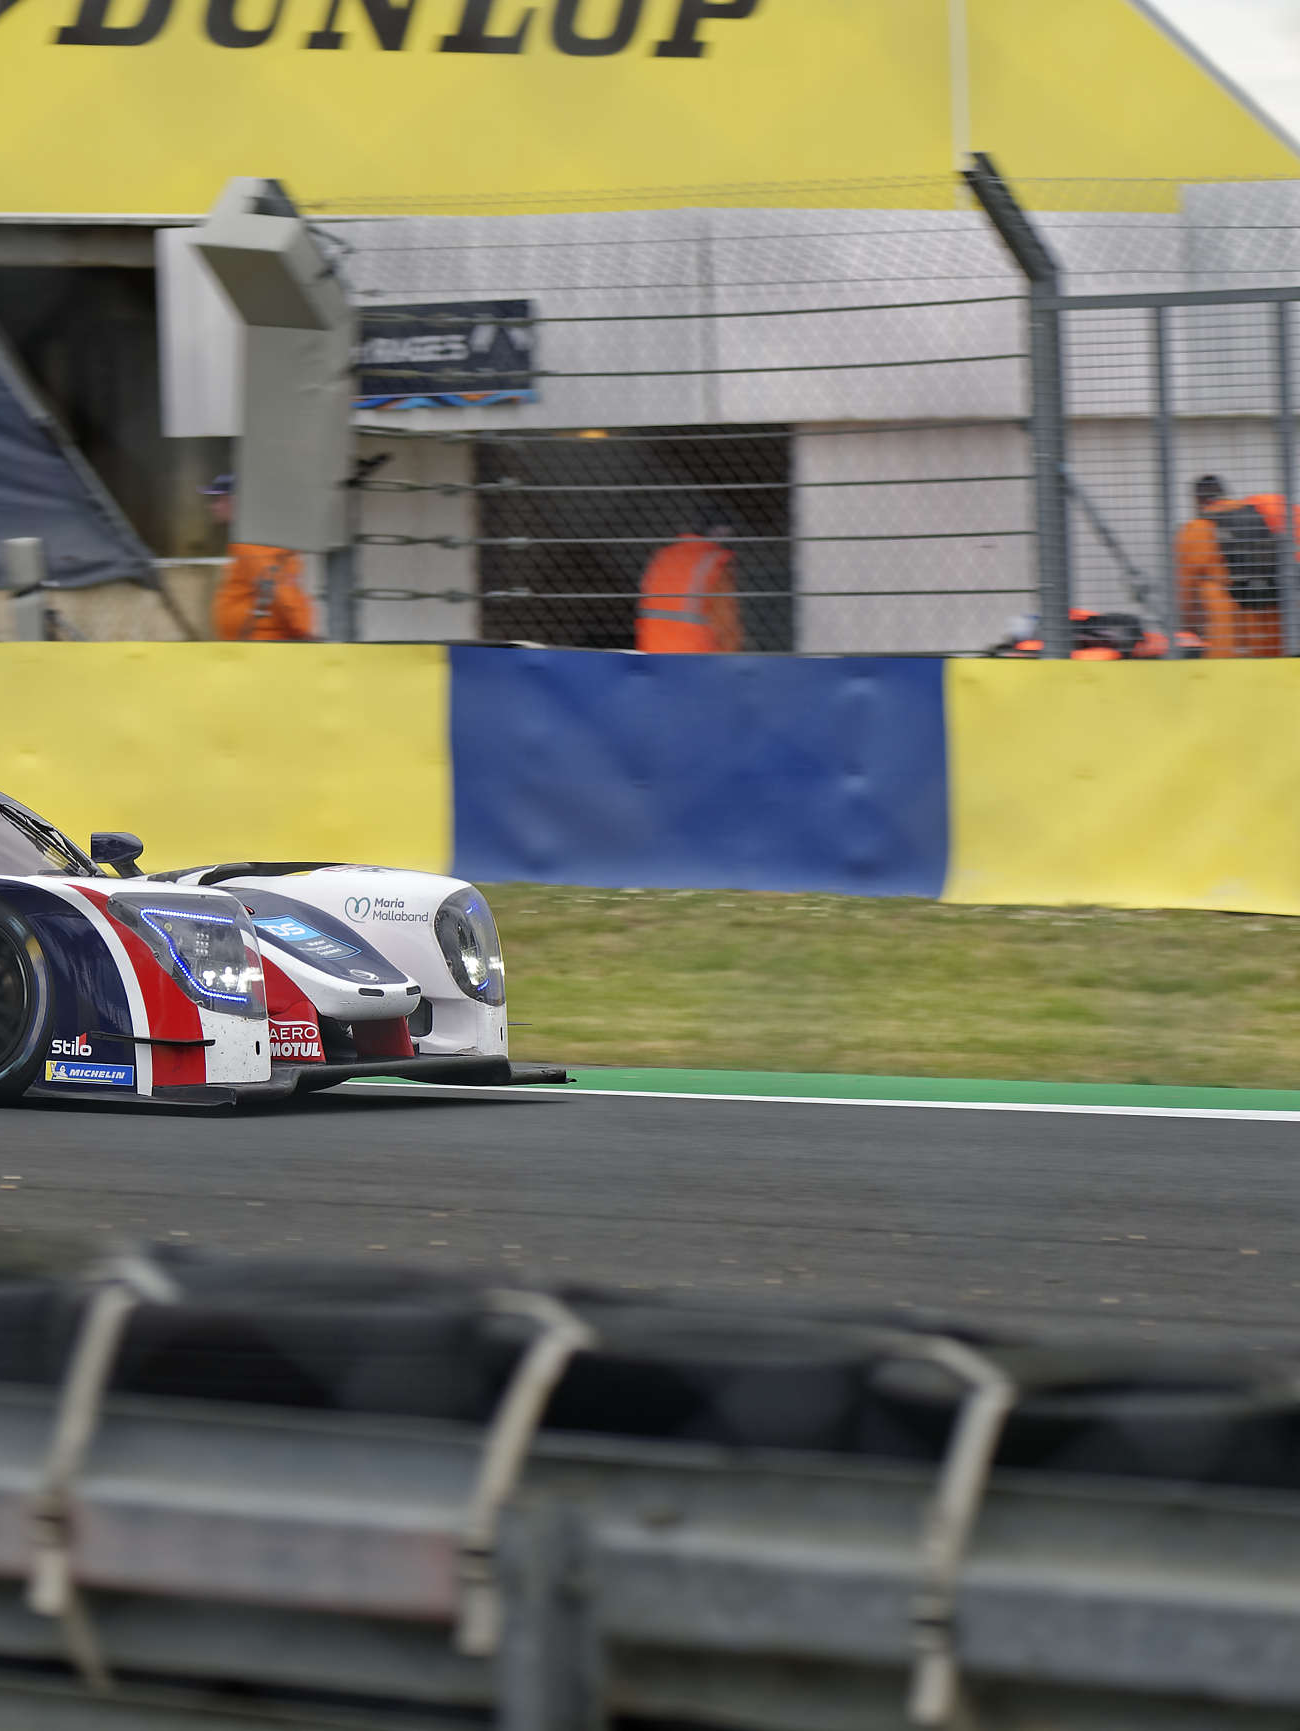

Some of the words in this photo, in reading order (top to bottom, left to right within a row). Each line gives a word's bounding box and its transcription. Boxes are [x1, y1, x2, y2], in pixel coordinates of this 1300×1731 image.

[374, 898, 405, 909] Maria
[372, 911, 429, 923] Mallaband
[270, 1026, 318, 1040] AERO
[51, 1033, 92, 1057] Stilo
[270, 1042, 321, 1057] MOTUL
[69, 1068, 126, 1080] MICHELIN
